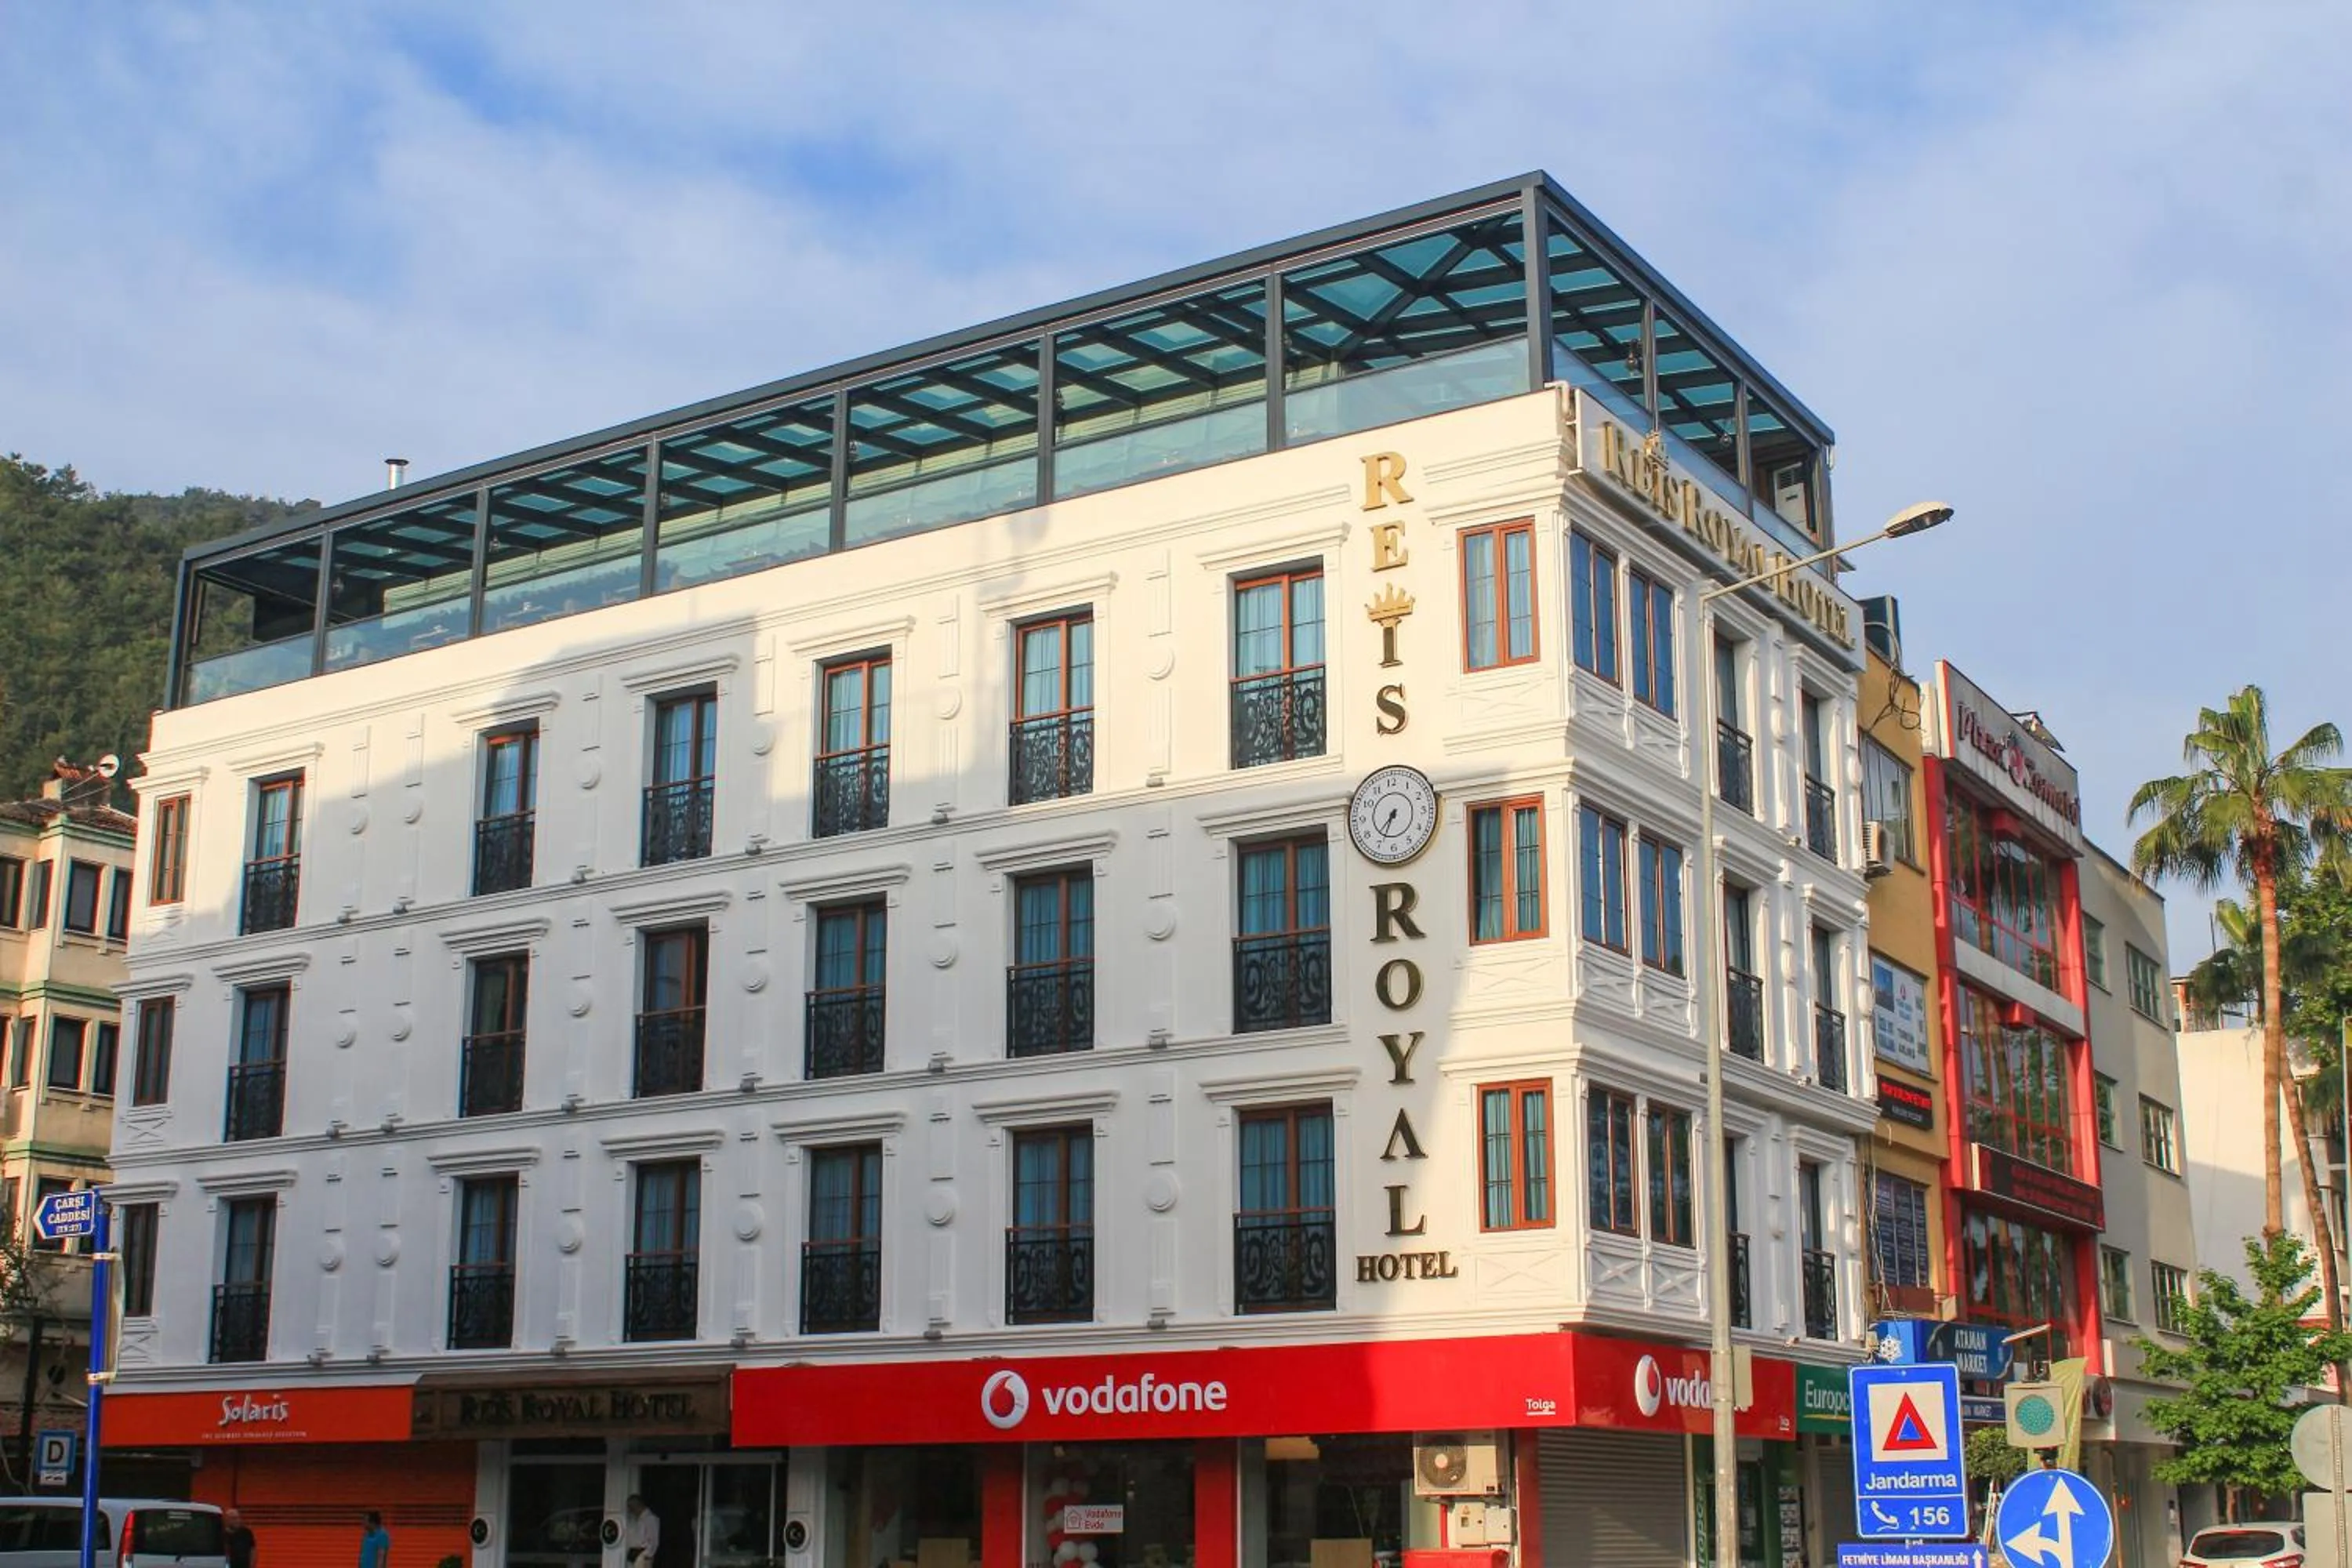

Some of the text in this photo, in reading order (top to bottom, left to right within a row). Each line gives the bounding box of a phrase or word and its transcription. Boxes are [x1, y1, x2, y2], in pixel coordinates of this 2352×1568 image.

[1369, 881, 1426, 1236] ROYAL
[1356, 1251, 1458, 1283] HOTEL
[1043, 1374, 1227, 1414] vodafone
[1525, 1398, 1556, 1412] Tolga
[1806, 1379, 1850, 1417] Europc
[218, 1393, 289, 1425] Solaris
[48, 1441, 64, 1463] D
[1865, 1471, 1958, 1490] Jandarma
[1909, 1506, 1950, 1526] 156
[1842, 1552, 1969, 1567] FETHİYE LİMAN BAŞKANLIĞI
